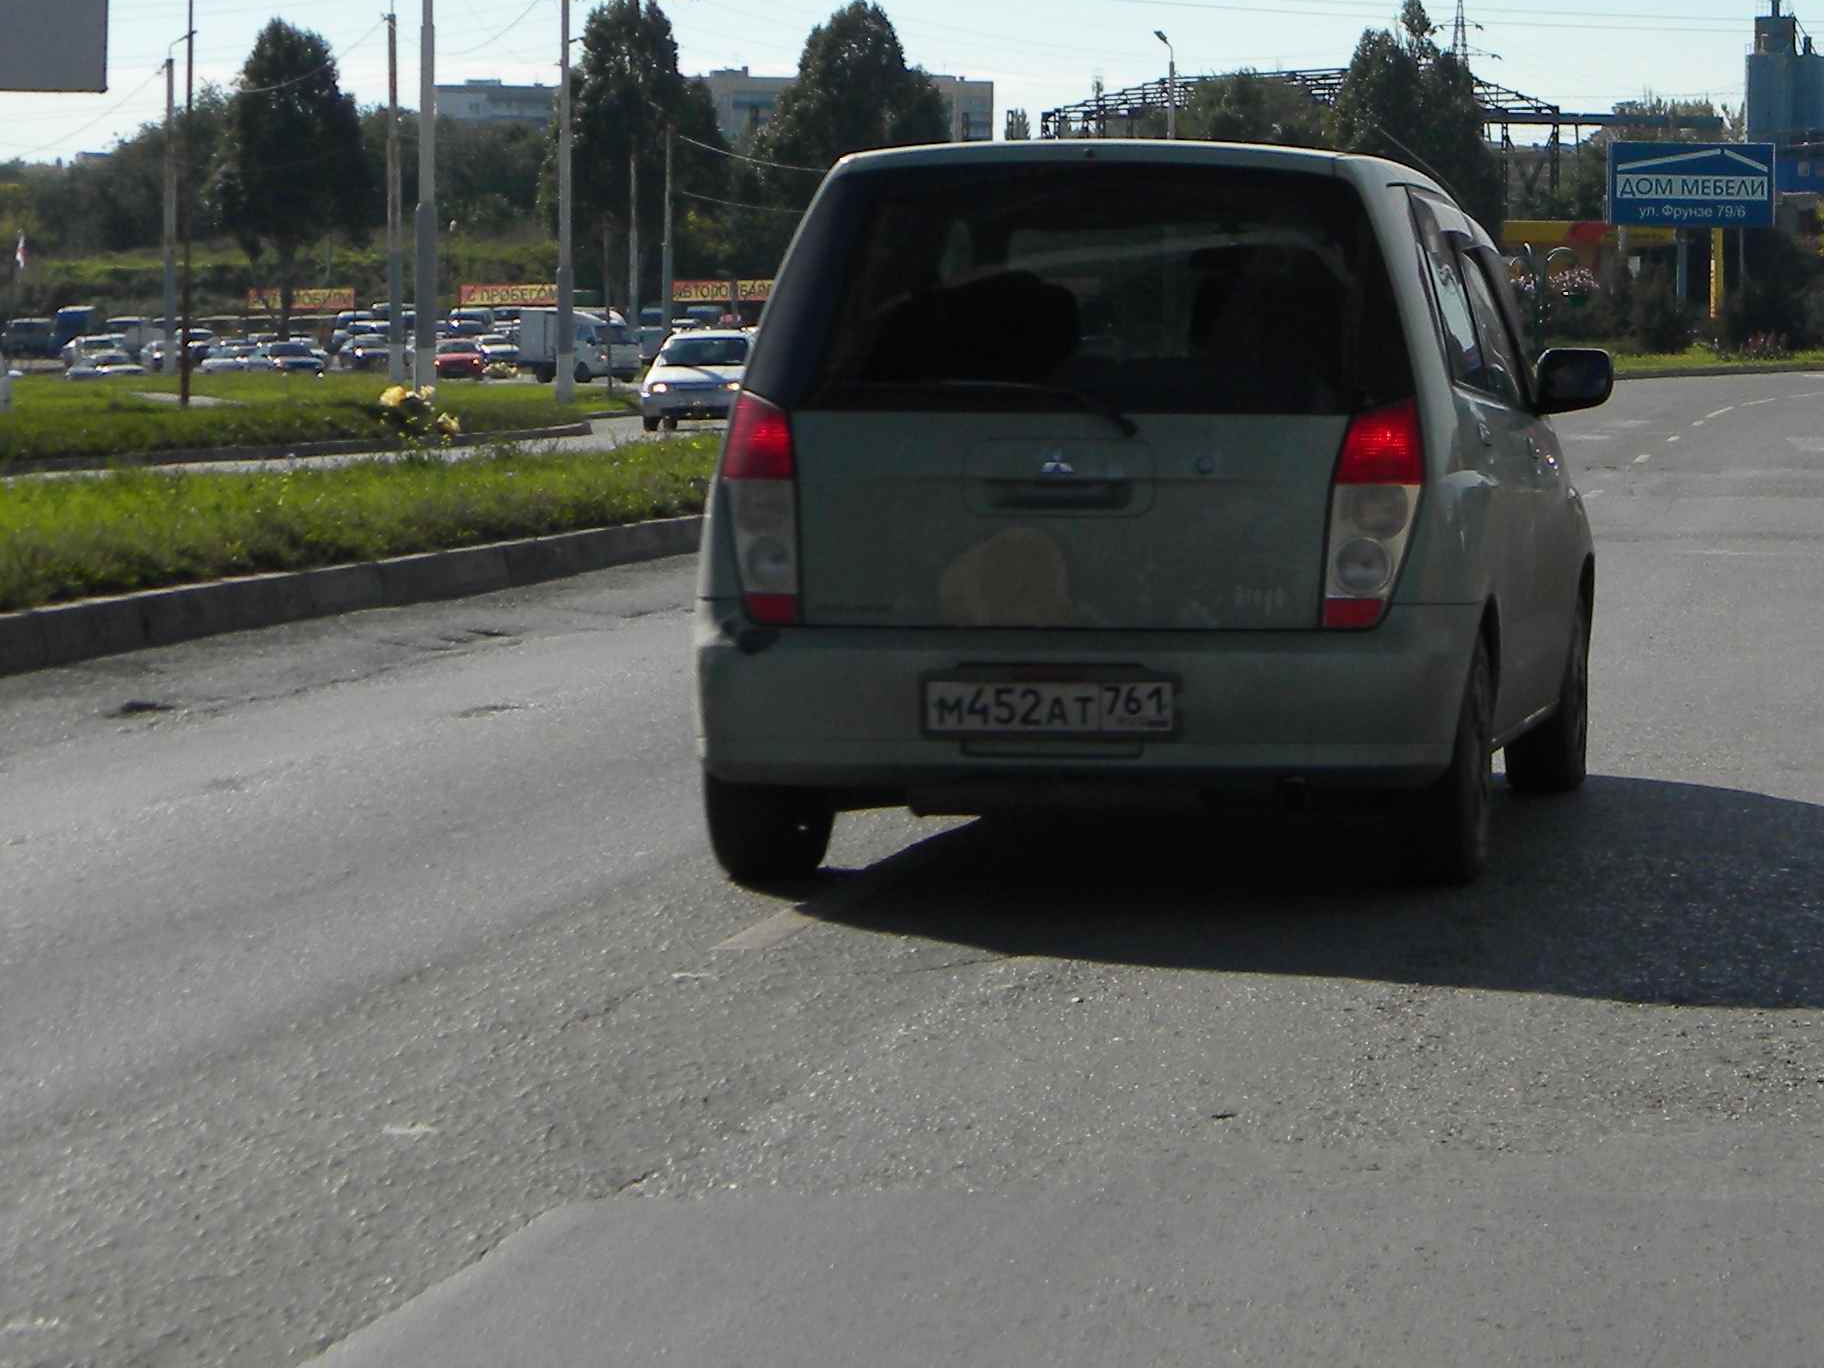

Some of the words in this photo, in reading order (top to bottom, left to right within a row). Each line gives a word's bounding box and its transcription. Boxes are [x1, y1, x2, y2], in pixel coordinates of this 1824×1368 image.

[1619, 177, 1673, 198] ДОМ
[1679, 178, 1765, 198] МЕБЕЛИ
[1639, 206, 1659, 219] ул.
[1661, 204, 1713, 220] Фрунзе
[480, 286, 557, 303] ПРОБЕГОМ
[934, 686, 1096, 726] М452АТ
[1103, 685, 1168, 715] 761
